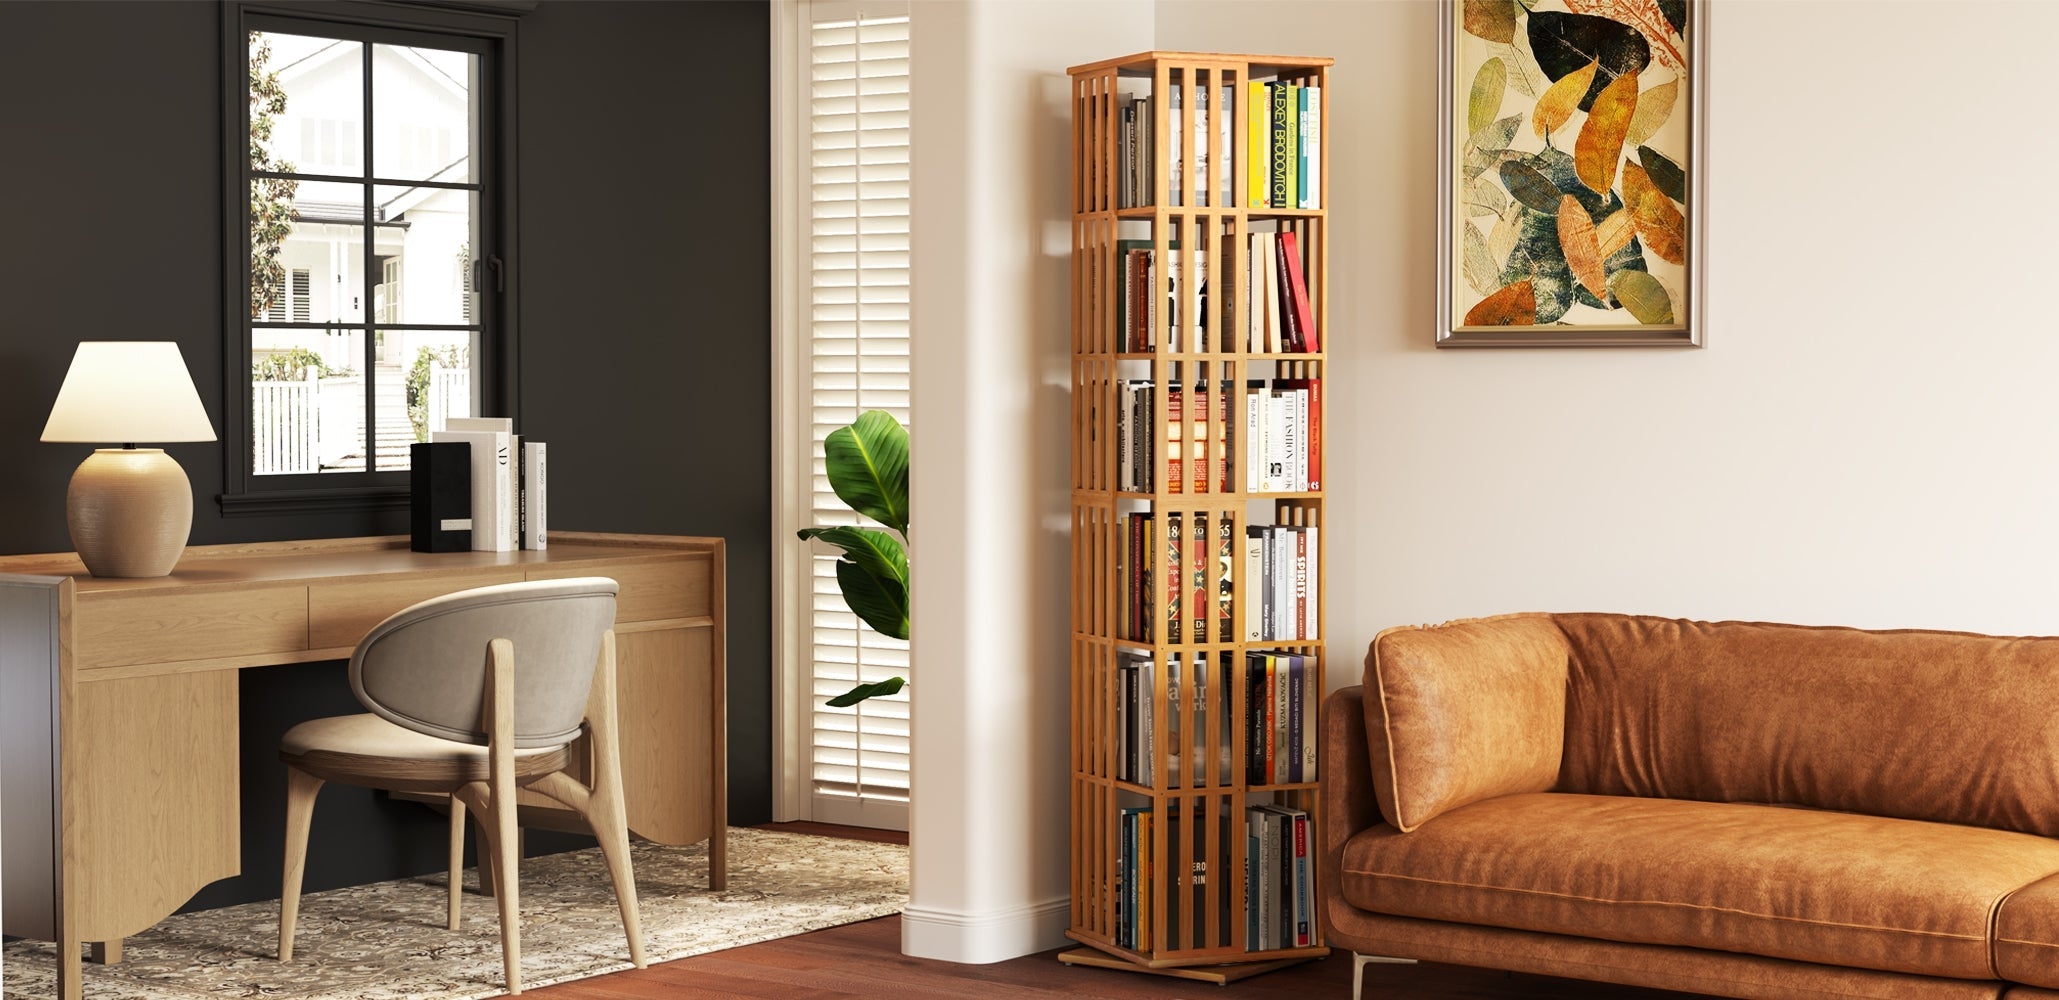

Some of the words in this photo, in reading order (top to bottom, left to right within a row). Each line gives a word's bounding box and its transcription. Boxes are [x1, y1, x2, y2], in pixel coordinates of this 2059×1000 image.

[1274, 84, 1286, 127] ALEXEY
[1288, 122, 1296, 147] Gardens
[1274, 129, 1286, 201] BRODOVITCH
[1288, 155, 1296, 175] France
[1285, 394, 1293, 415] THE
[1285, 416, 1293, 459] FASHION
[1285, 461, 1293, 490] BOOK
[1297, 556, 1306, 598] SPIRITS
[1271, 825, 1279, 860] NOPI
